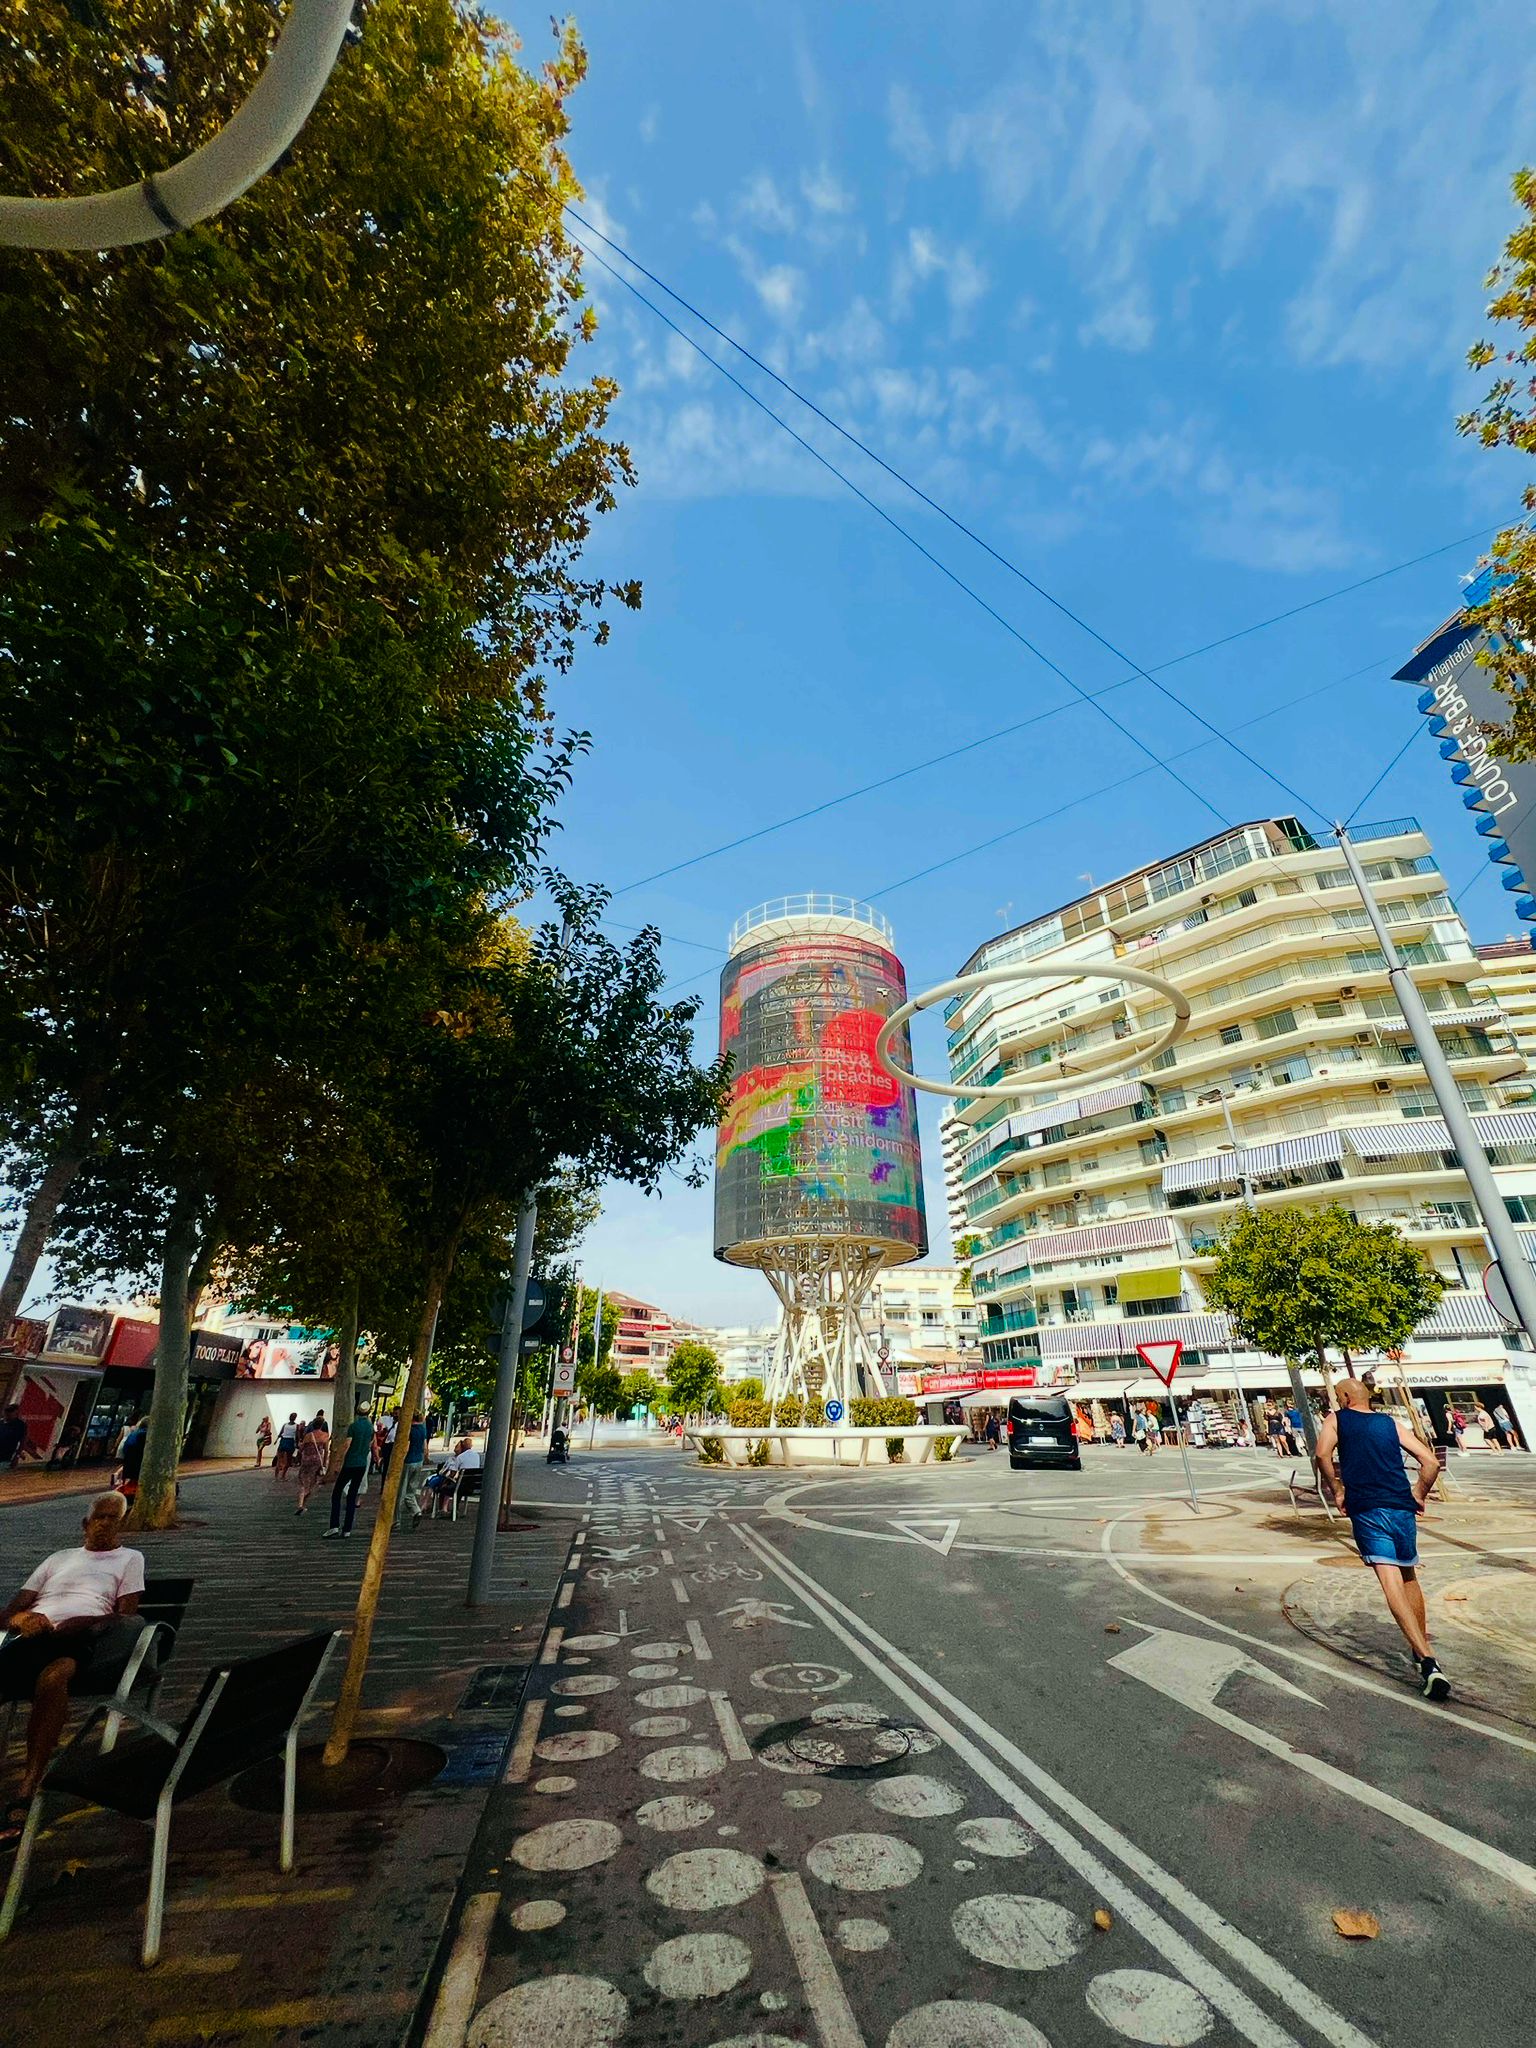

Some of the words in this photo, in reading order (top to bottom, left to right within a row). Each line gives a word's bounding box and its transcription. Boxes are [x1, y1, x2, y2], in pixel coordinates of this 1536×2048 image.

[1432, 638, 1474, 681] Planta20
[1434, 675, 1468, 722] BAR
[1452, 713, 1475, 735] &
[1458, 725, 1518, 817] LOUNGE
[826, 1066, 893, 1090] beaches
[824, 1114, 865, 1129] Visit
[824, 1128, 903, 1154] Benidorm
